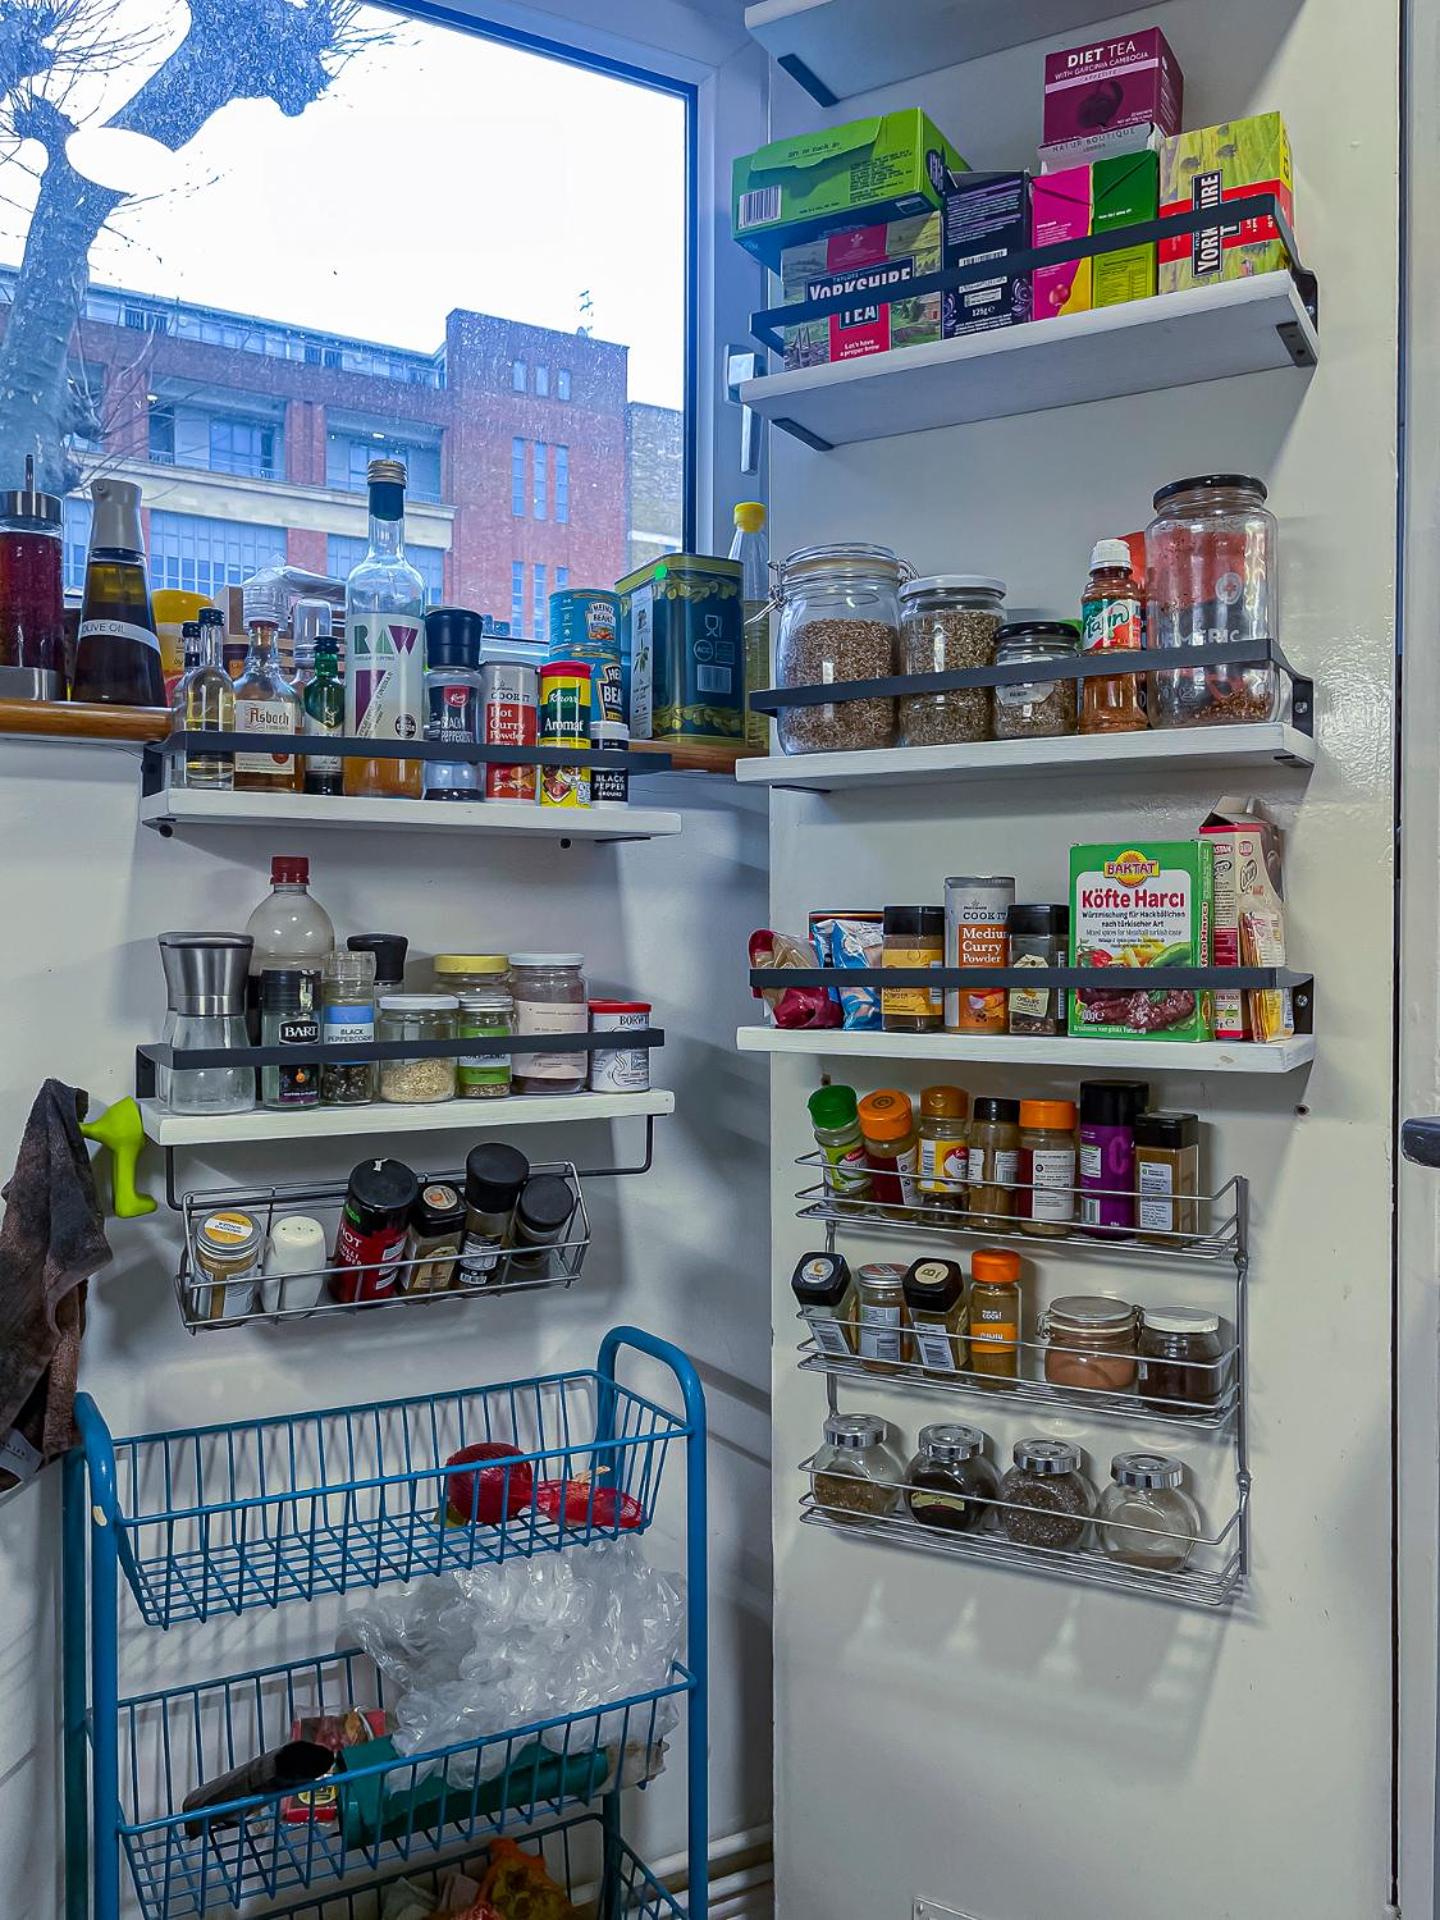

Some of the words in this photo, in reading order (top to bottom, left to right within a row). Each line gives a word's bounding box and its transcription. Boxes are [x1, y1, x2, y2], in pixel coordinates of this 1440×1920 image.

[1067, 47, 1104, 68] DIET
[1108, 40, 1136, 56] TEA
[354, 624, 419, 656] RAW
[249, 707, 290, 726] Asbach
[489, 705, 513, 718] Hot
[489, 718, 525, 735] Curry
[544, 717, 584, 732] Aromat
[489, 730, 526, 741] Powder
[595, 773, 625, 783] BLACK
[593, 782, 626, 792] PEPPER
[1107, 862, 1155, 875] BAKTAT
[1082, 887, 1131, 908] Köfte
[963, 911, 996, 921] COOK
[962, 940, 1002, 956] Curry
[962, 953, 1002, 964] Powder
[284, 1026, 317, 1038] BART
[340, 1028, 364, 1036] BLACK
